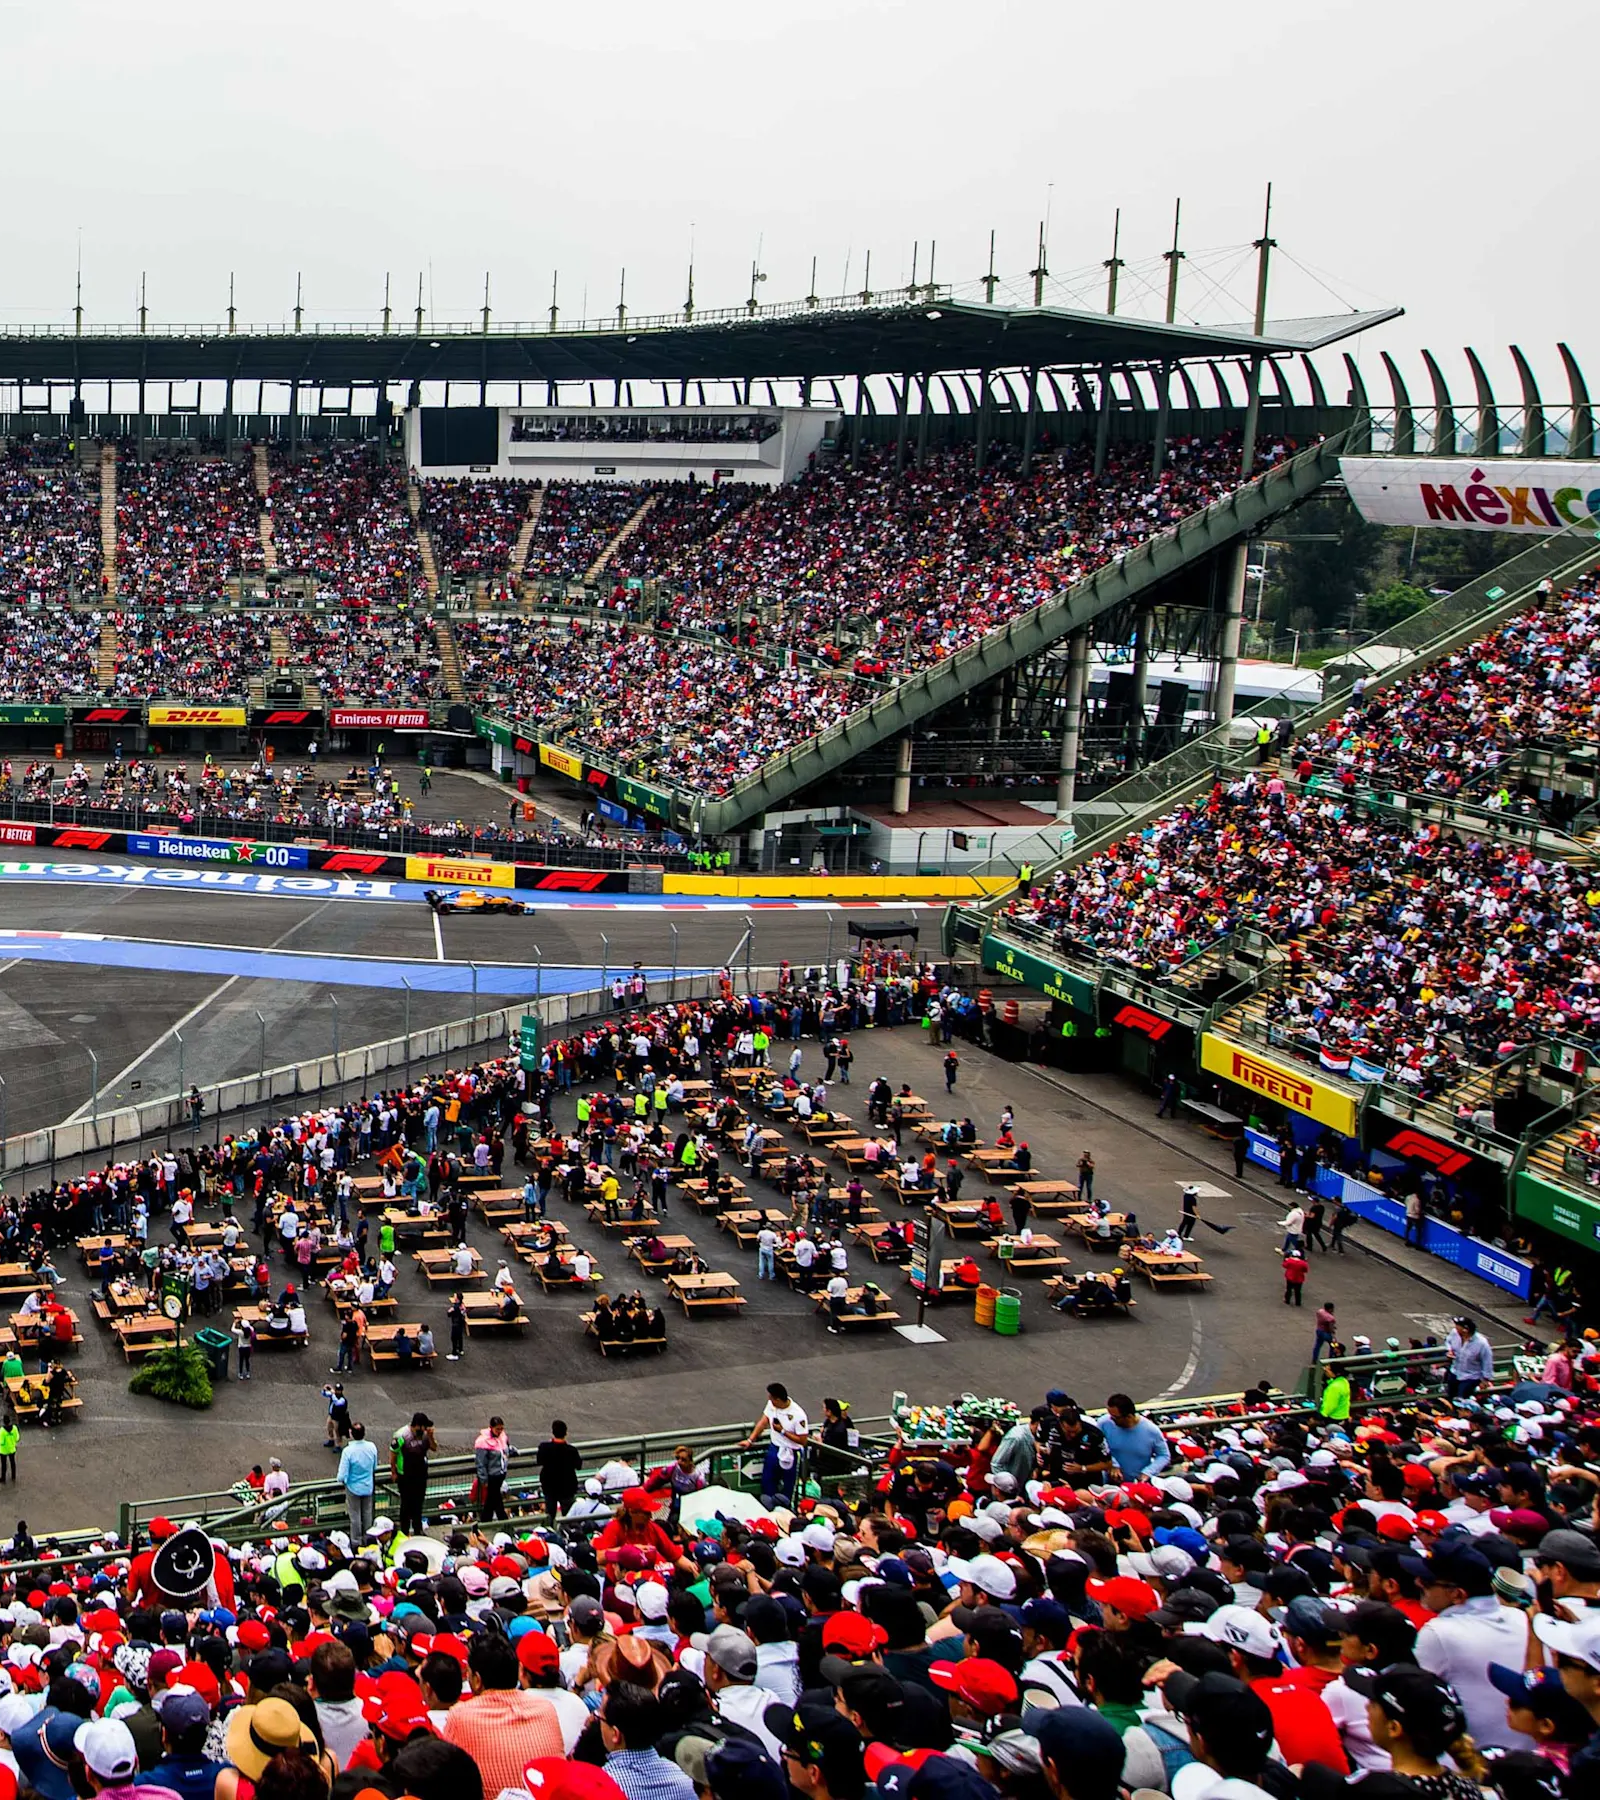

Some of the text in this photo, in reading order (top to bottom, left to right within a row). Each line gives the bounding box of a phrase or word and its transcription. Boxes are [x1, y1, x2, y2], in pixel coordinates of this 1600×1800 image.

[166, 711, 224, 722] DHL
[335, 714, 425, 725] Emirates FLY BETTER
[7, 829, 33, 842] BETTER
[158, 840, 231, 860] Heineken
[1, 862, 397, 899] Heineken
[428, 863, 492, 882] PIRELLI
[996, 961, 1025, 982] ROLEX
[1043, 983, 1074, 1005] ROLEX
[1232, 1051, 1313, 1111] PIRELLI
